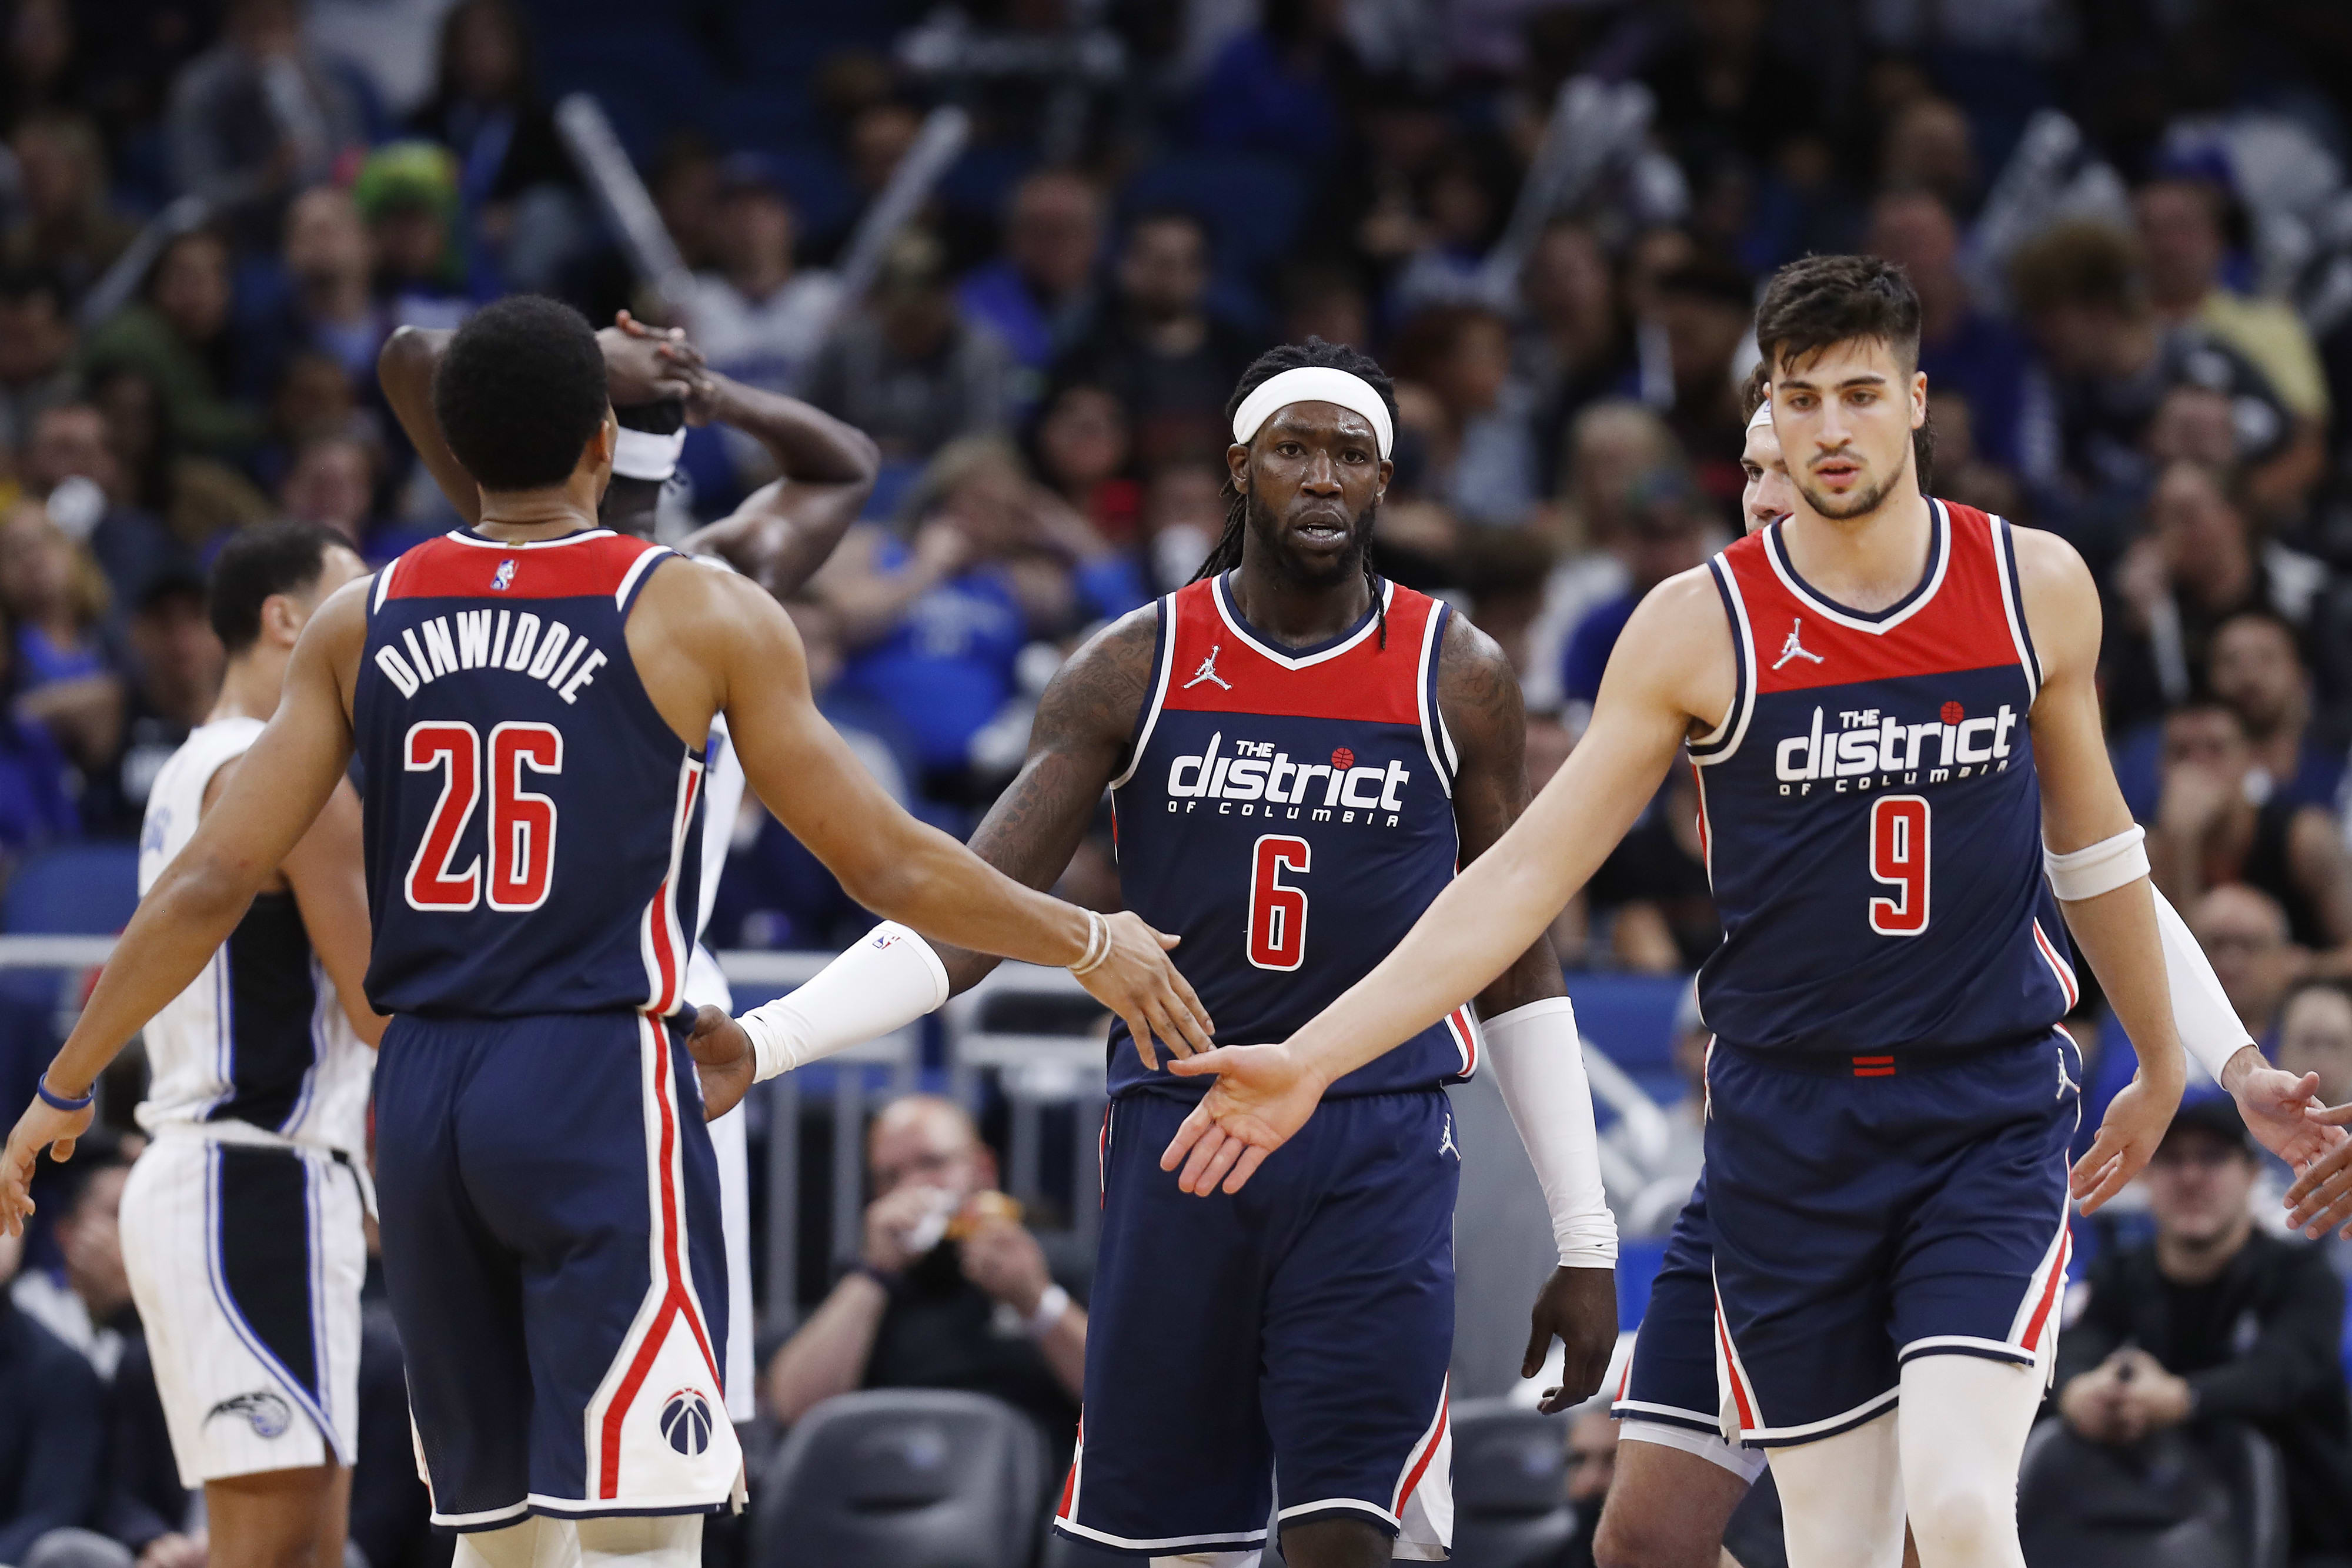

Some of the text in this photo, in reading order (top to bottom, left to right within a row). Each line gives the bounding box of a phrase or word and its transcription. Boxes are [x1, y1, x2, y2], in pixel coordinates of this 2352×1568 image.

[374, 609, 609, 705] DINWIDDIE
[1236, 740, 1275, 758] THE
[1775, 701, 2017, 782] district
[1839, 708, 1880, 728] THE
[1167, 730, 1411, 812] district
[1779, 759, 2009, 797] OF COLUMBIA
[404, 720, 564, 912] 26
[1168, 800, 1399, 827] OF COLUMBIA
[1246, 833, 1312, 972] 6
[1868, 794, 1932, 937] 9
